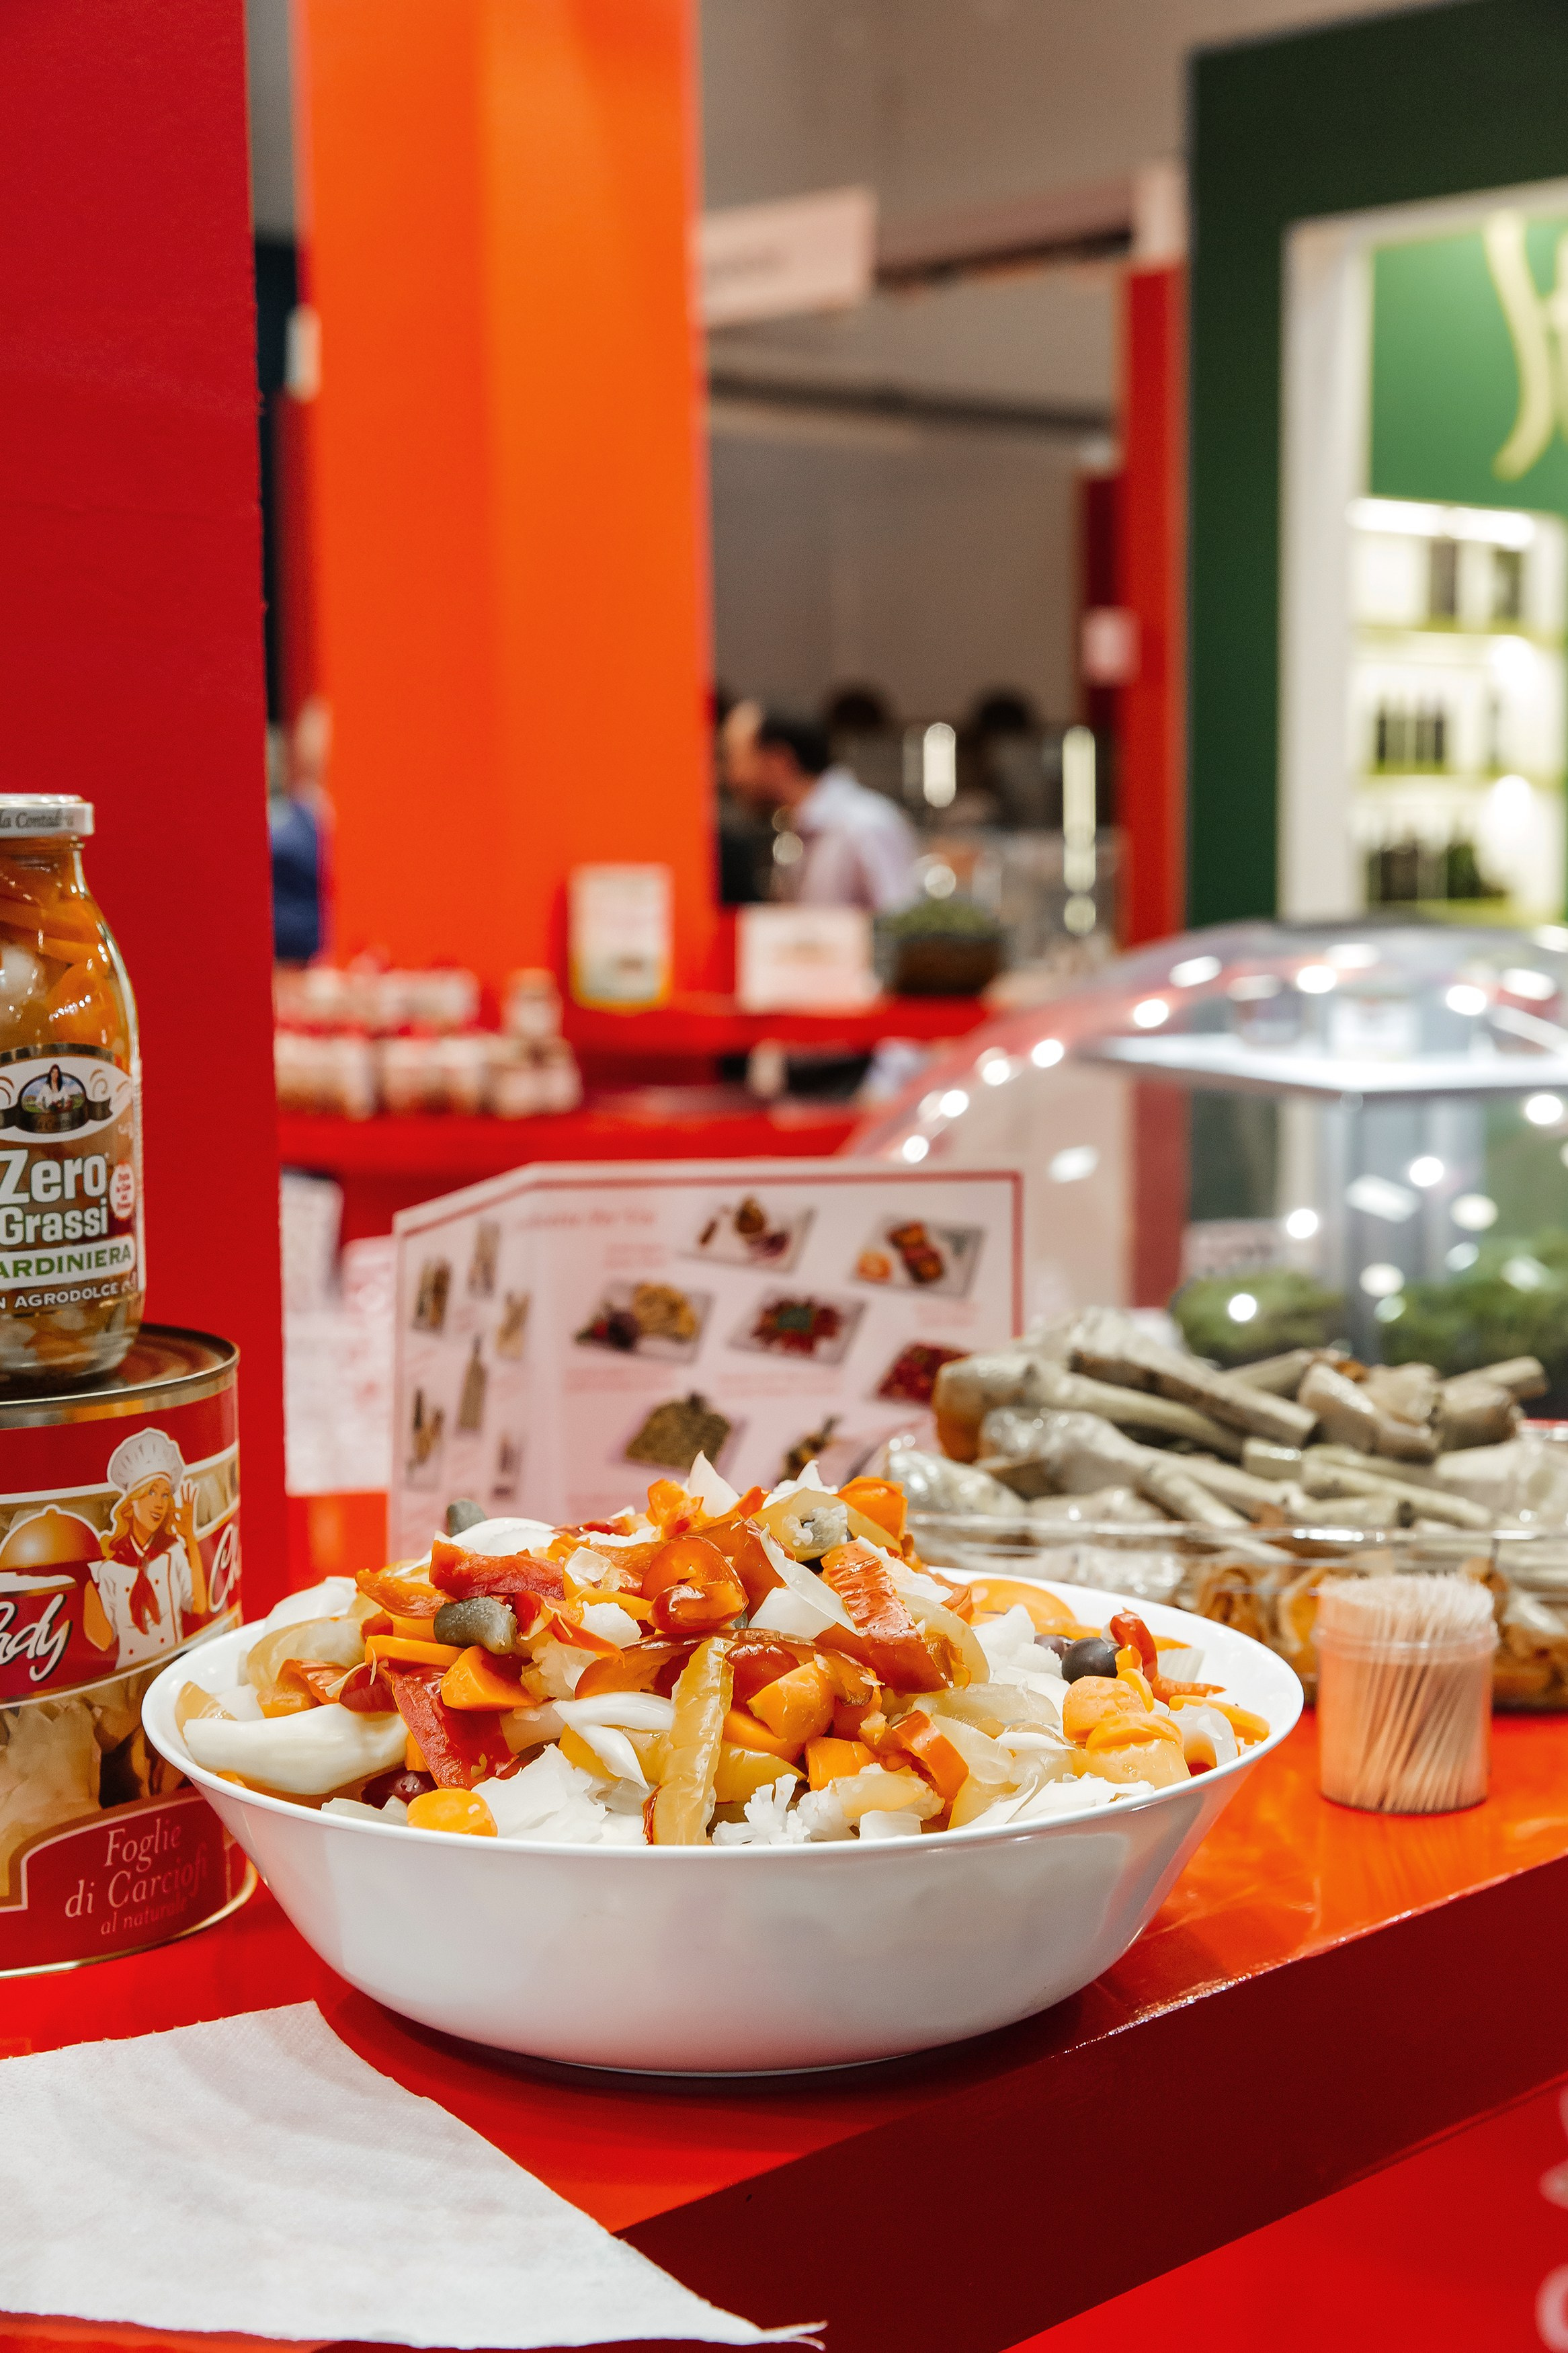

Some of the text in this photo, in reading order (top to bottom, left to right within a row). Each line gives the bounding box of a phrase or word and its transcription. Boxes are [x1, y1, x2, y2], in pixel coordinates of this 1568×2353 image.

[0, 1149, 107, 1205] Zero
[0, 1197, 108, 1246] Grassi
[14, 1281, 119, 1308] AGRODOLCE
[104, 1818, 181, 1872] Foglie
[65, 1841, 208, 1917] di Carciofi
[101, 1890, 187, 1935] al naturale
